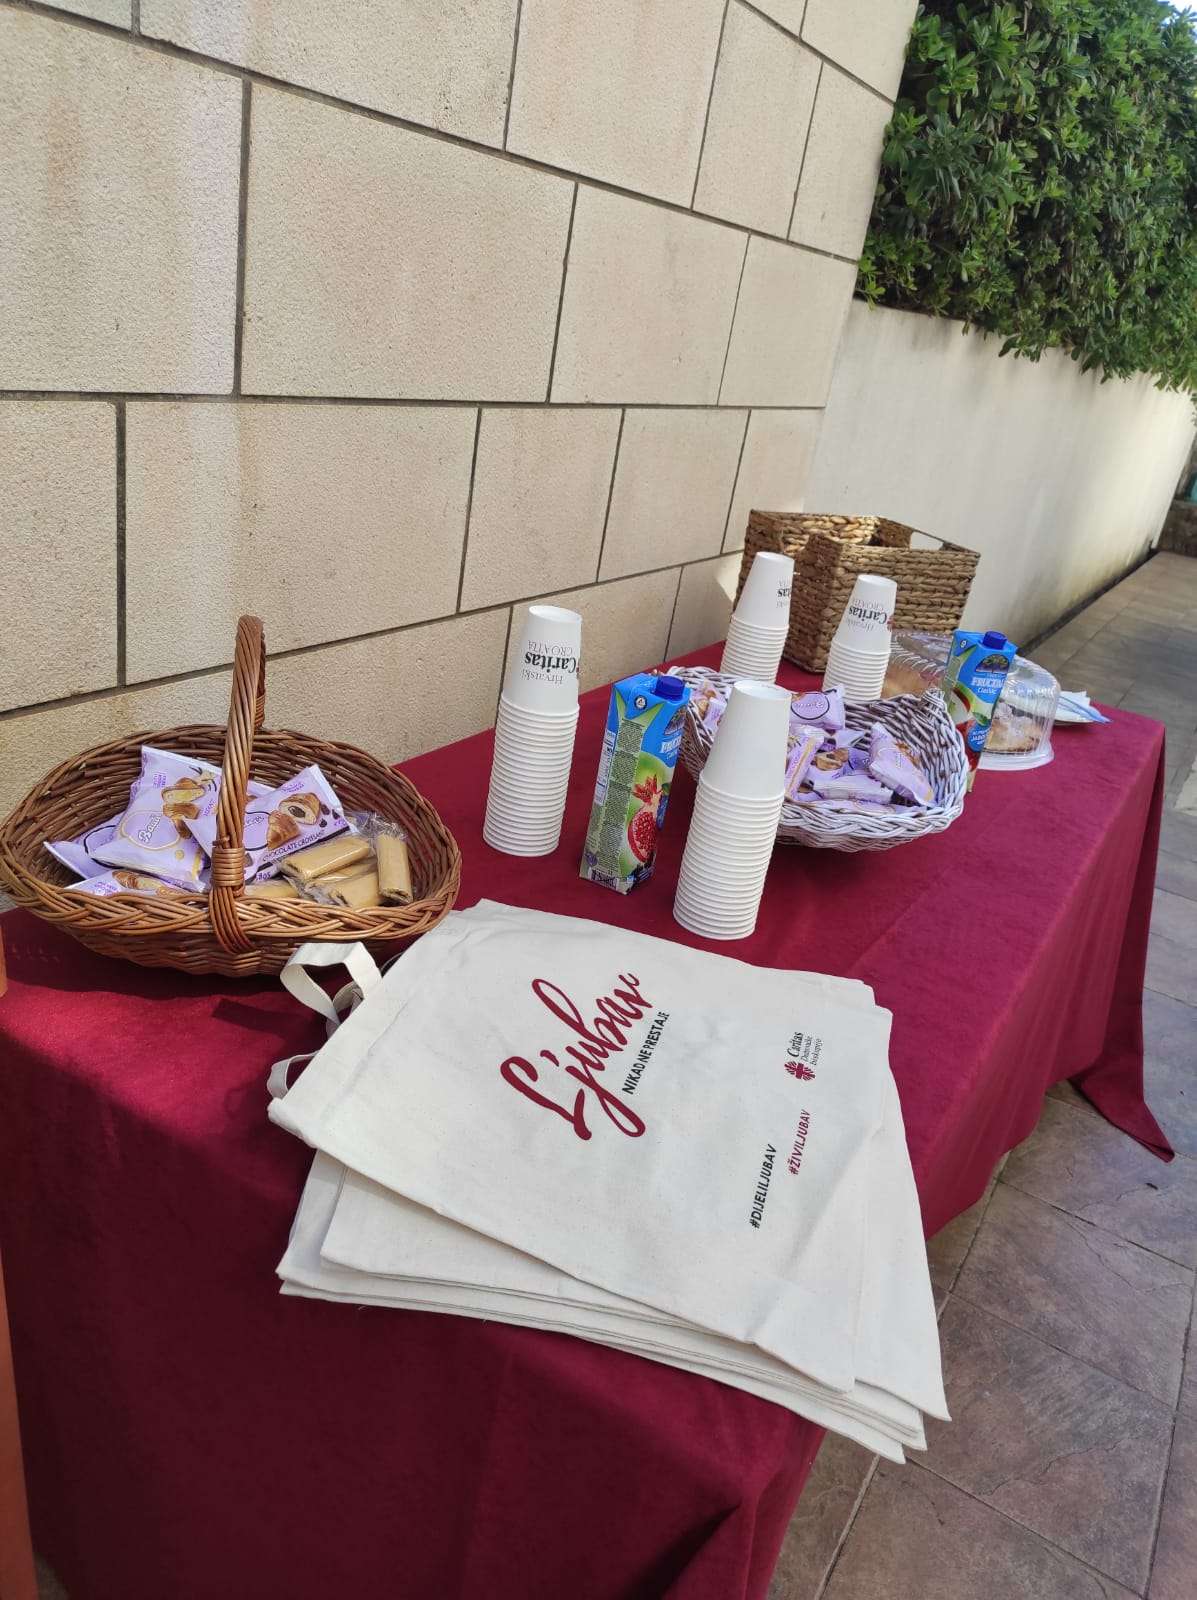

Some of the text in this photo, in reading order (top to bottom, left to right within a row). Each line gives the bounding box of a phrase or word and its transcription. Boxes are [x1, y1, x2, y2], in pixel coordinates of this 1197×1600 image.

[848, 605, 888, 625] Caritas
[524, 652, 578, 673] Caritas
[621, 1012, 670, 1095] NIKAD NE PRESTAJE
[786, 1032, 804, 1058] Caritas
[787, 1109, 811, 1176] #ŽIVILJUBAV
[749, 1144, 777, 1229] #DIJELILJUBAV
